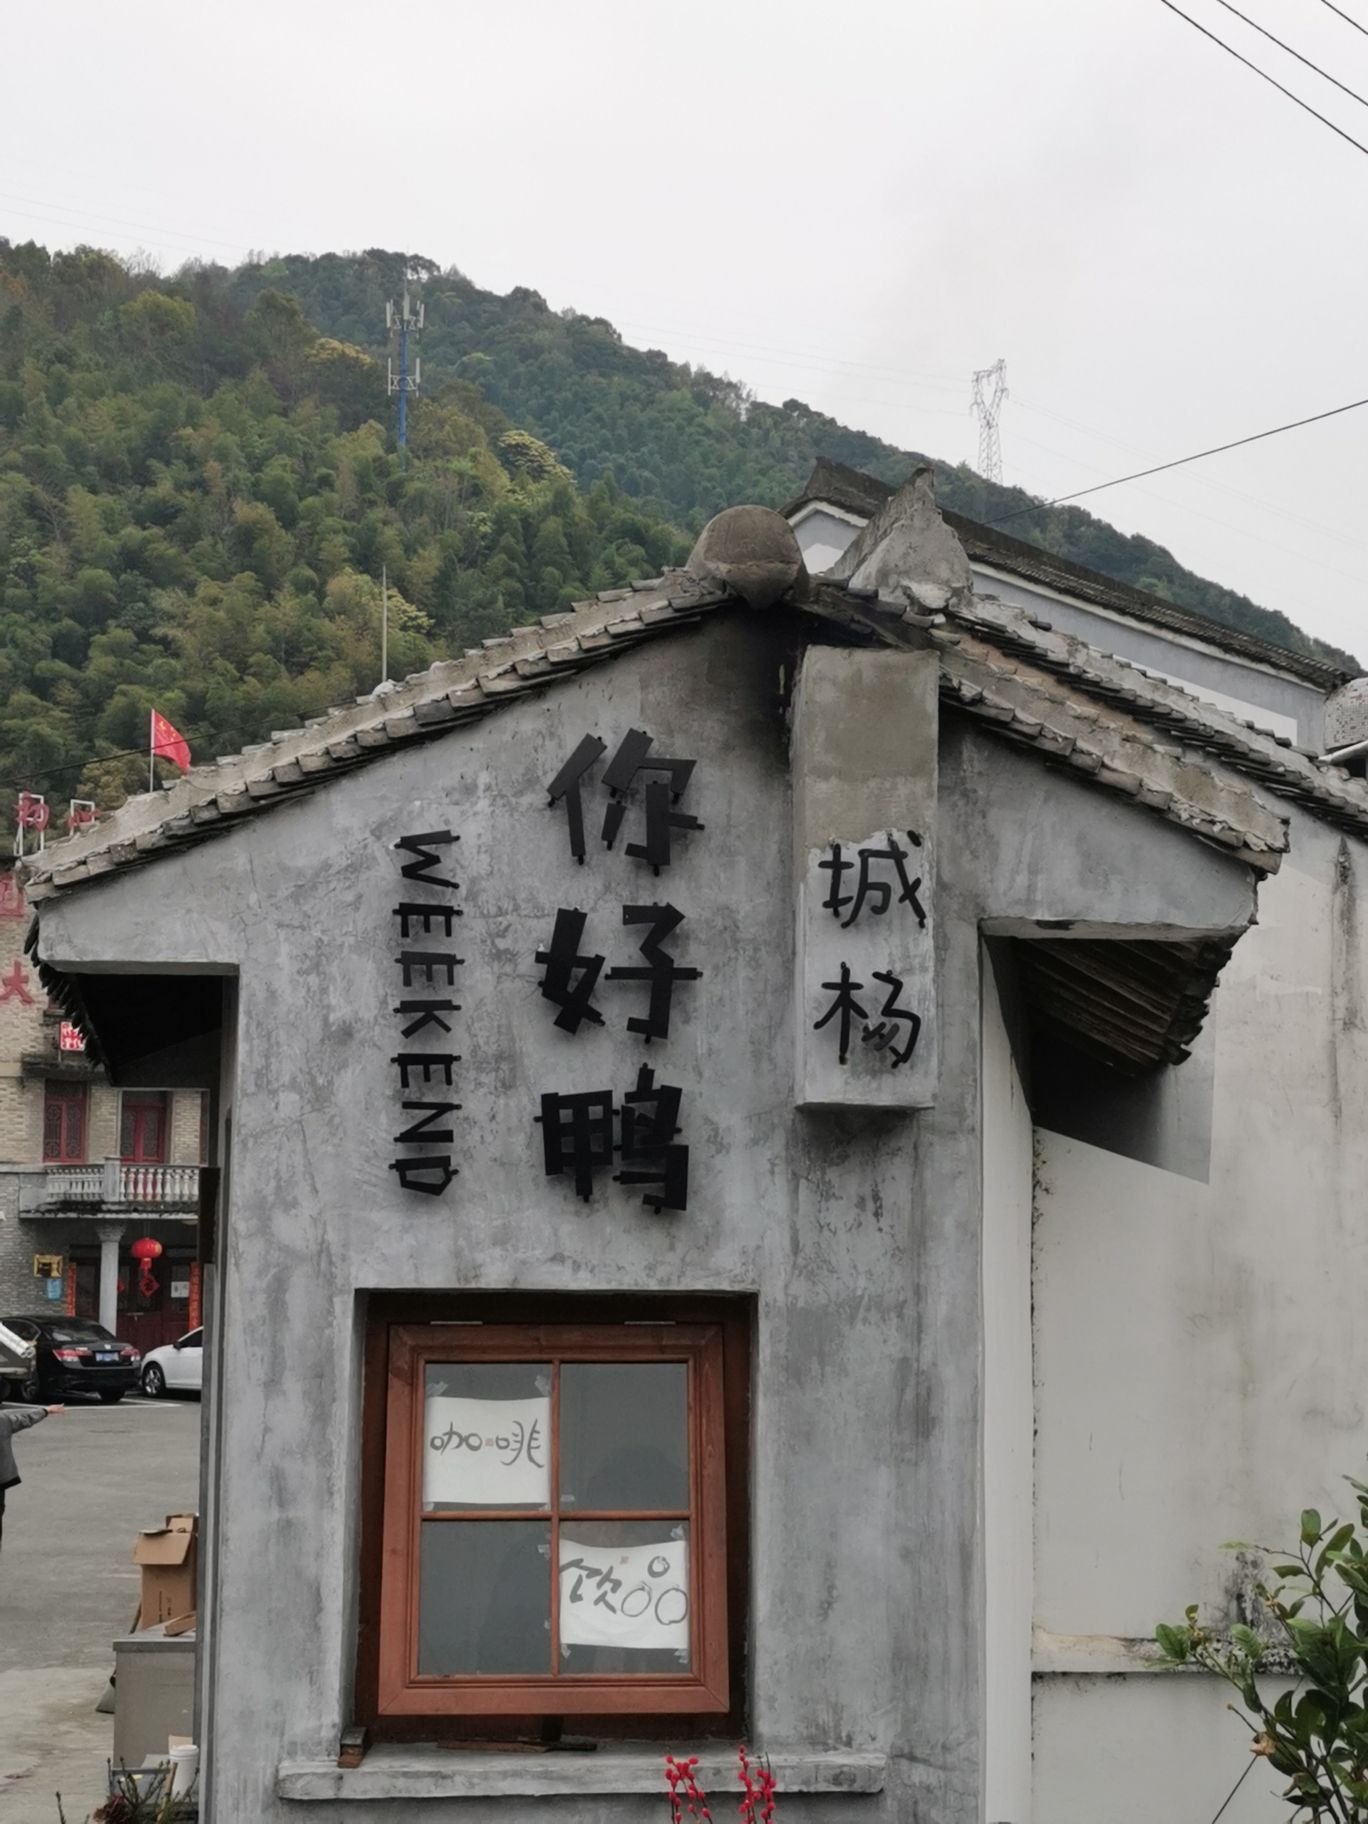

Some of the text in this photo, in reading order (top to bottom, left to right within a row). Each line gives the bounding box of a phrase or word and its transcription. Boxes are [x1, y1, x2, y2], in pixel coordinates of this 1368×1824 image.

[388, 829, 465, 1196] WEEKEND
[534, 728, 706, 1213] 你好鸭
[813, 829, 929, 1068] 城杨
[429, 1418, 545, 1468] 咖啡
[559, 1555, 689, 1626] 饮品
